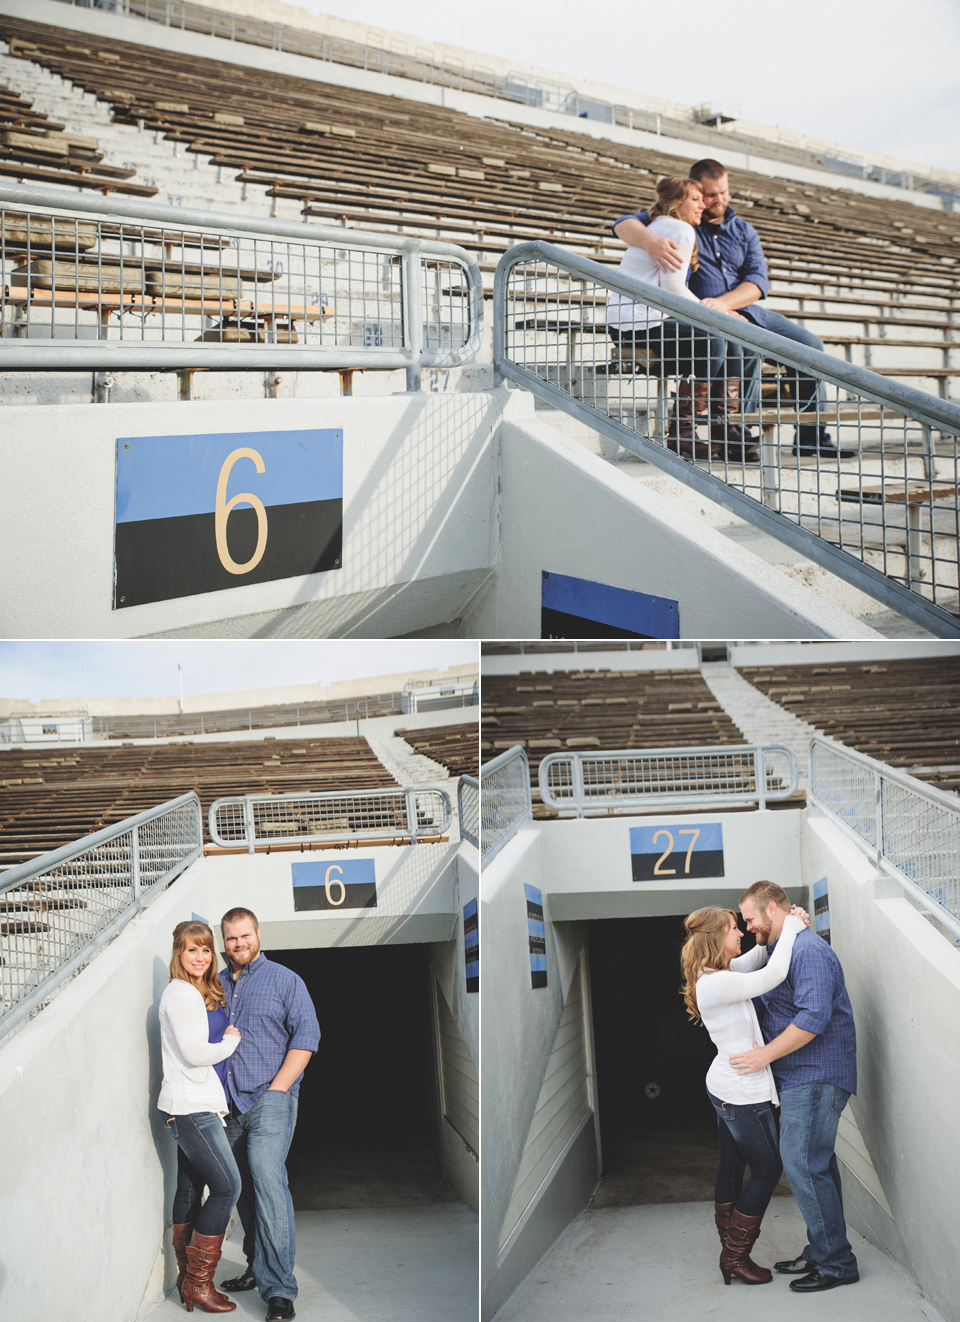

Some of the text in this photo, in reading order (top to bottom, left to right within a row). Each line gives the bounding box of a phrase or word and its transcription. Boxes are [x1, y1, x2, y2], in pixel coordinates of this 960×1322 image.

[430, 370, 450, 393] 27
[214, 447, 268, 575] 6
[652, 829, 701, 876] 27
[324, 864, 346, 906] 6
